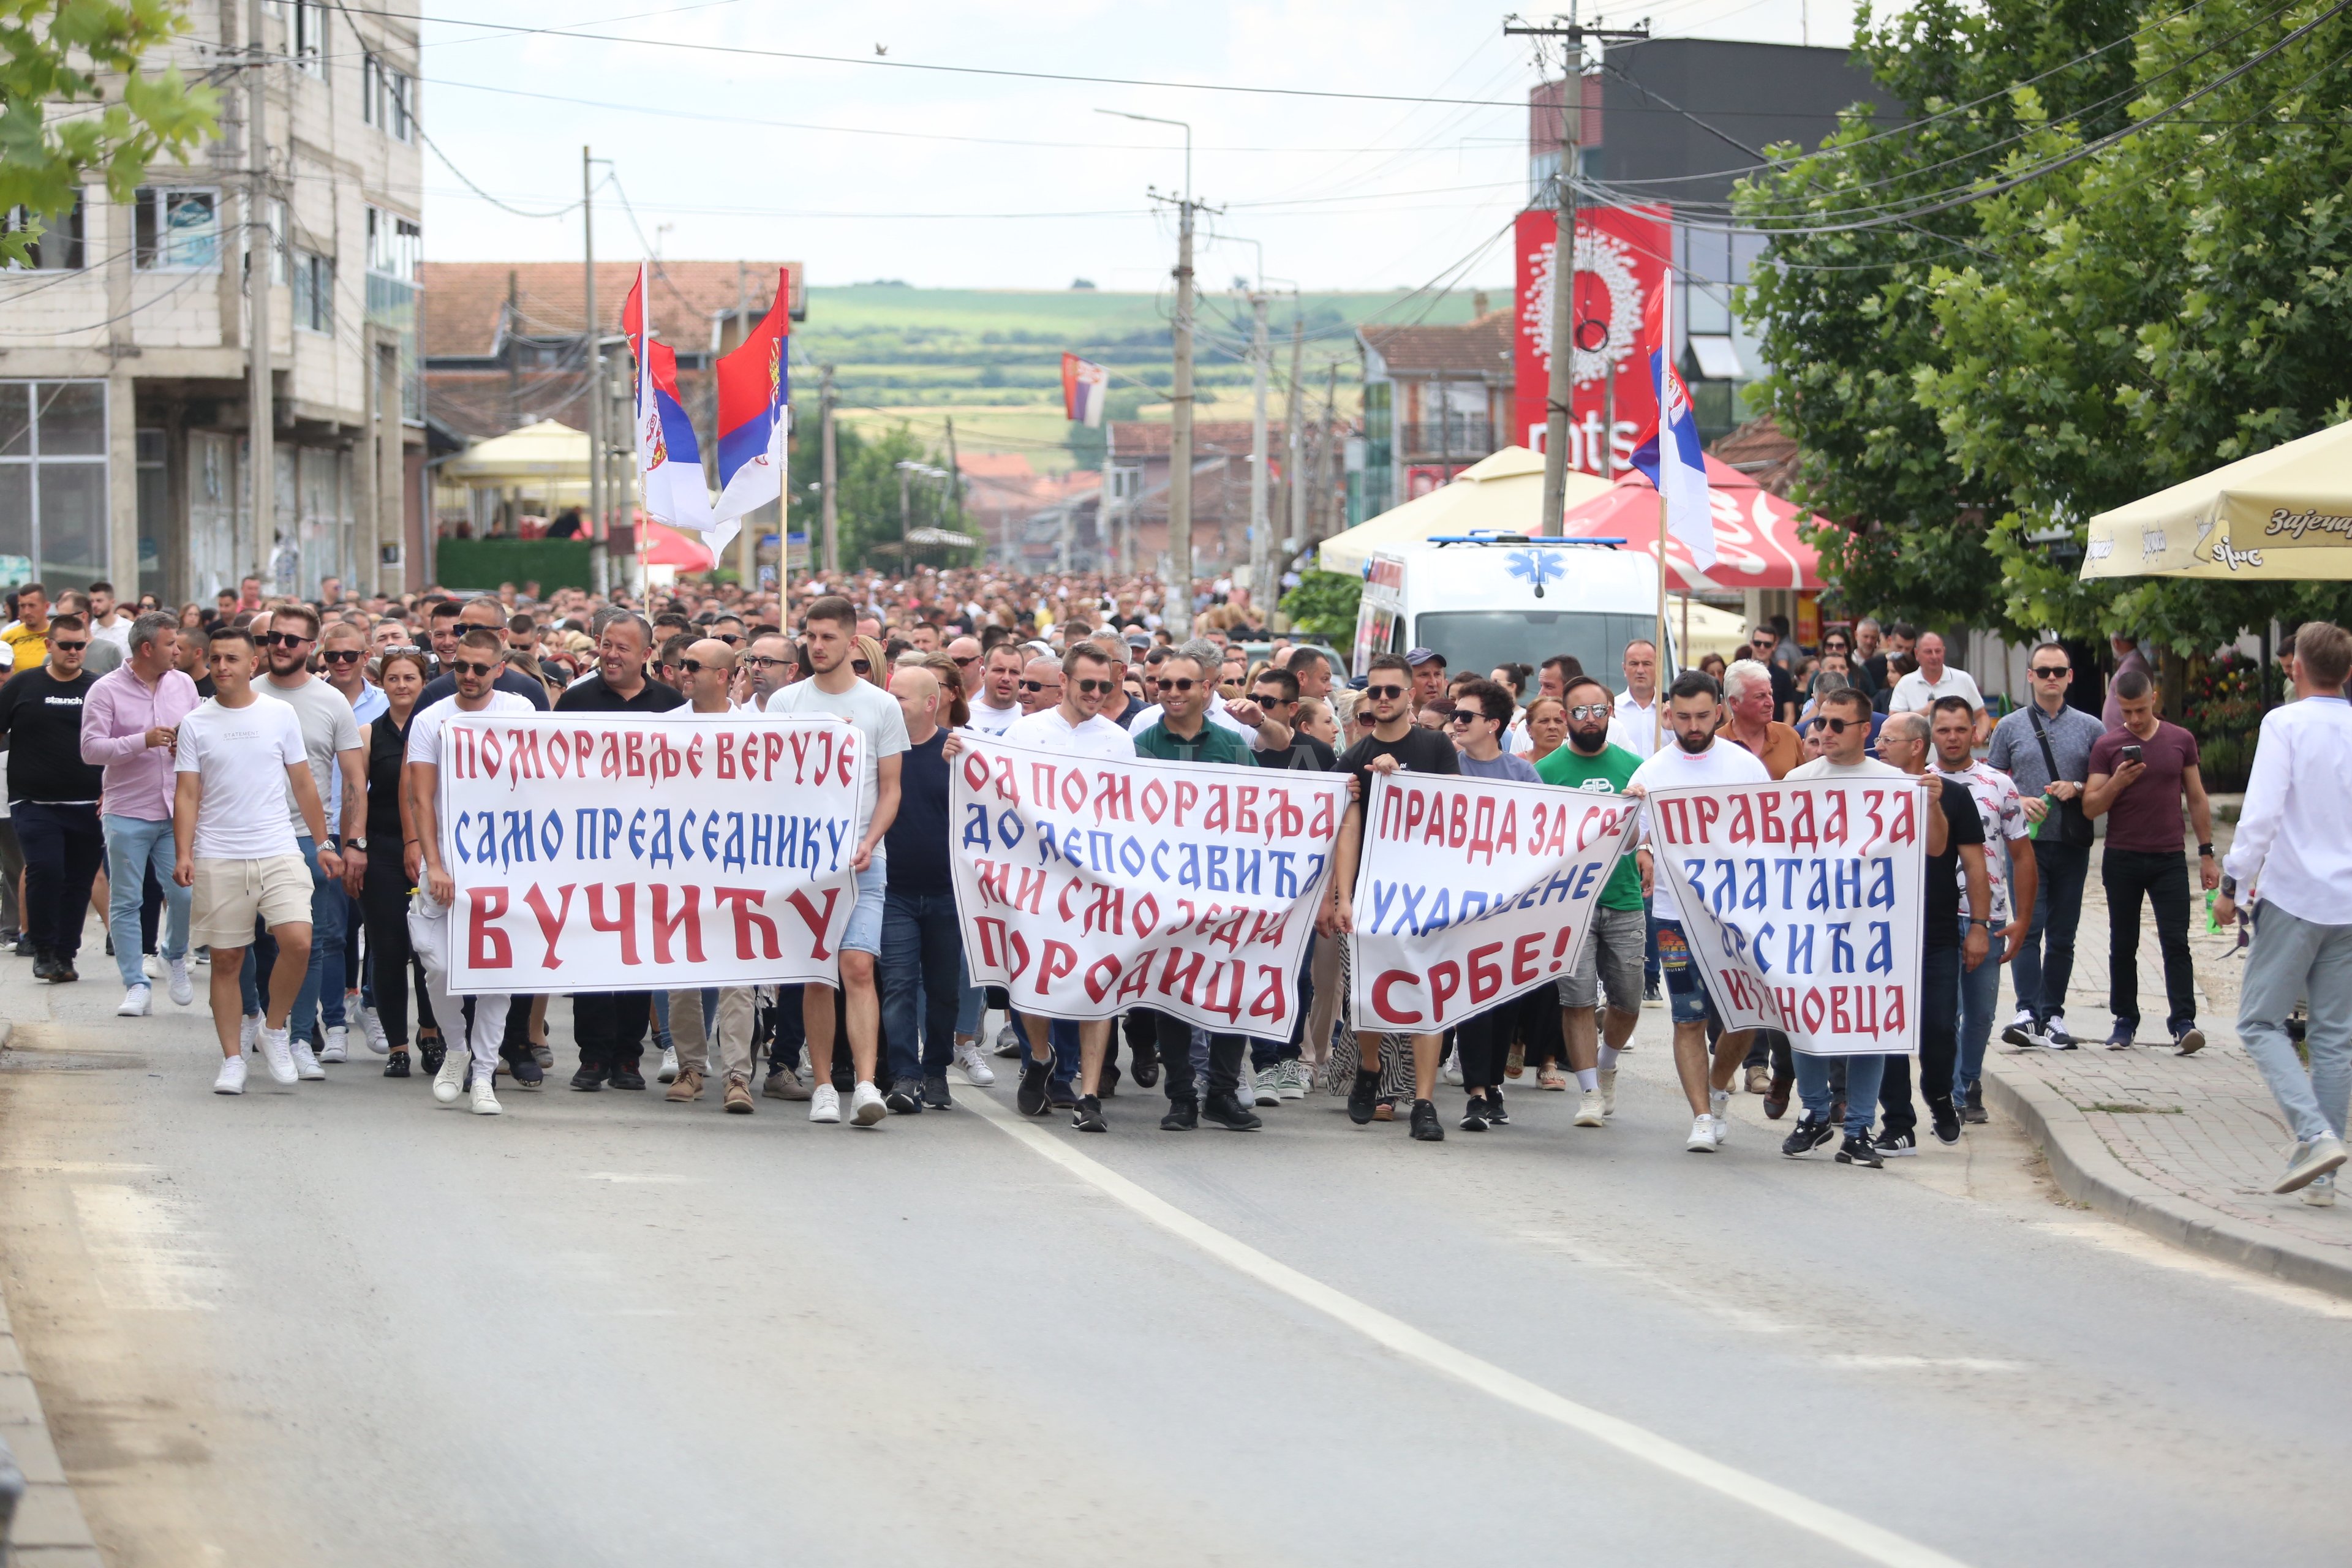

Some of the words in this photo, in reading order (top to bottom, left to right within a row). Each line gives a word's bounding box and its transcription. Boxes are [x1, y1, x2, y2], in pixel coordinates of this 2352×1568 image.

[45, 696, 83, 704] staunch
[453, 726, 704, 791] ПОМОРАВЉЕ
[715, 731, 856, 788] ВЕРУЈЕ
[963, 749, 1020, 809] ОД
[1031, 762, 1335, 846] ПОМОРАВЉА
[454, 808, 564, 875] САМО
[575, 807, 850, 882] ПРЕДСЕДНИКУ
[962, 803, 1025, 853] ДО
[1036, 820, 1325, 899] ЛЕПОСАВИЋА
[1379, 785, 1517, 866] ПРАВДА
[1528, 802, 1565, 857] ЗА
[1657, 789, 1848, 854] ПРАВДА
[1858, 790, 1915, 856] ЗА
[466, 881, 841, 970] ВУЧИЋУ
[974, 858, 1047, 915] МИ
[1057, 875, 1159, 940] СМО
[1166, 898, 1294, 953] ЈЕДНА
[1683, 856, 1895, 915] ЗЛАТАНА
[972, 916, 1286, 1025] ПОРОДИЦА
[1371, 925, 1571, 1025] СРБЕ!
